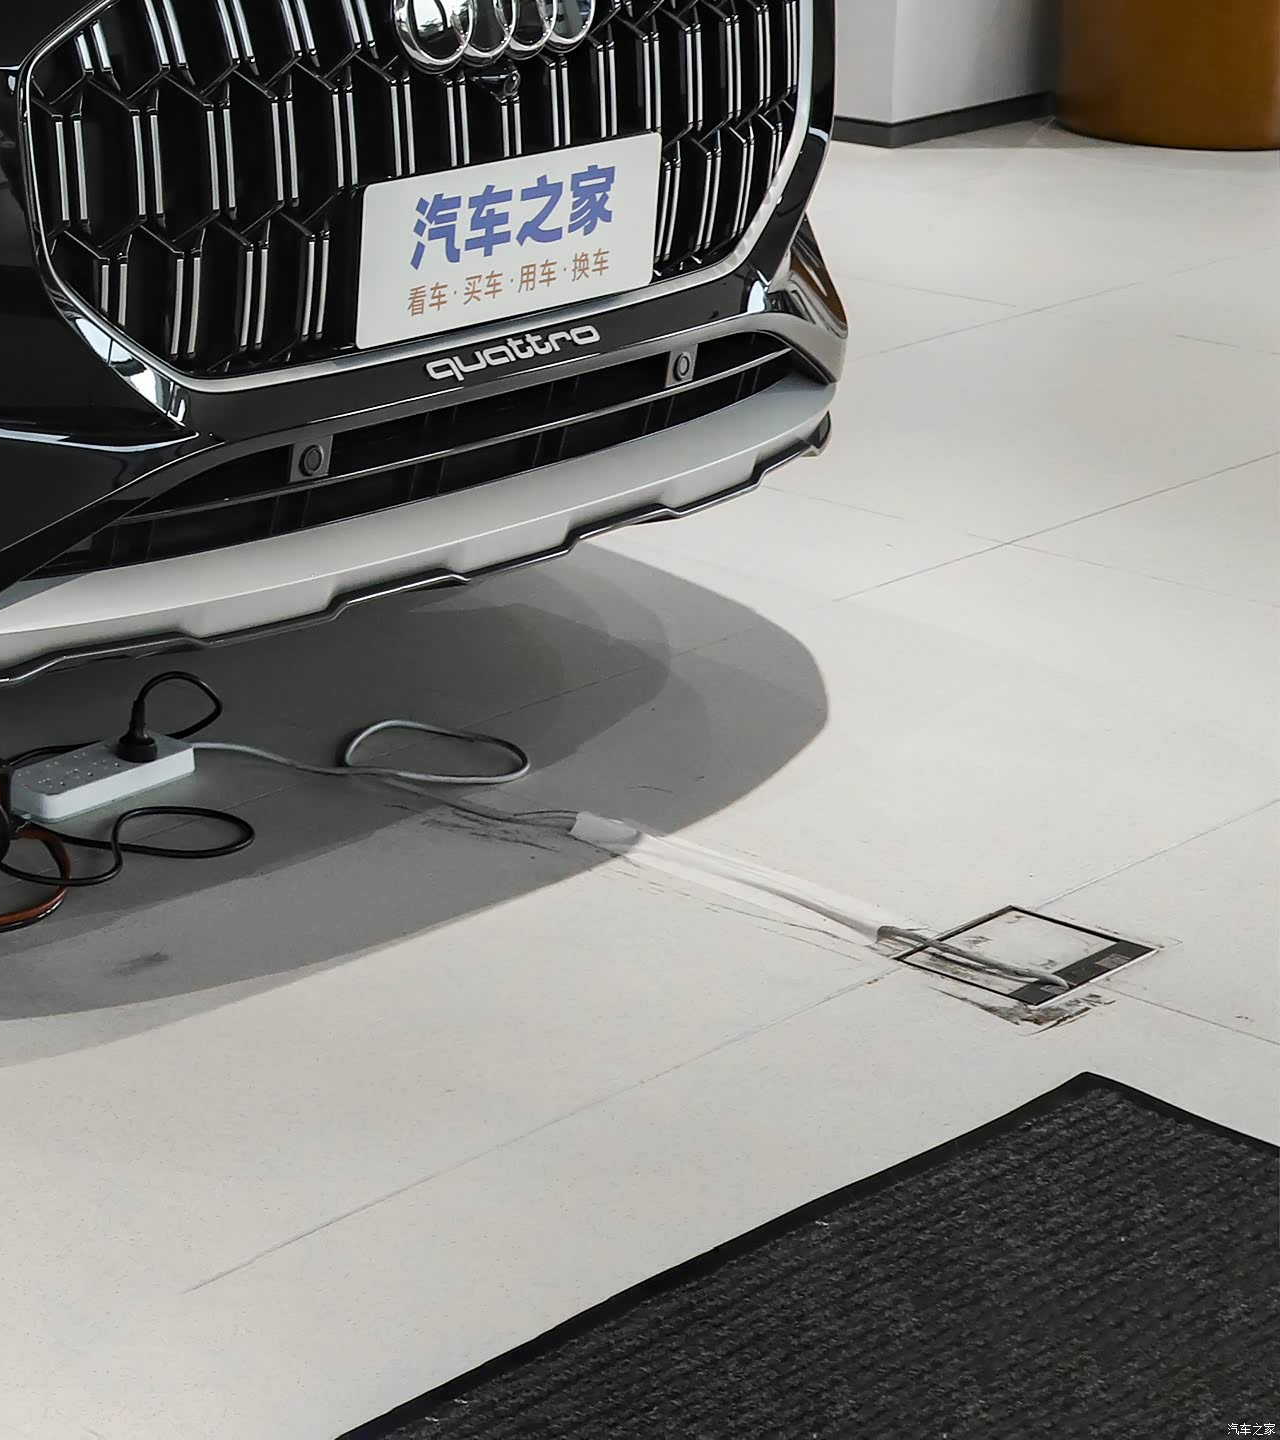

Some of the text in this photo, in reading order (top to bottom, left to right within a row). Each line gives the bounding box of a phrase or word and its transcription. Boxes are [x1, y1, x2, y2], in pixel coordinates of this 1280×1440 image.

[410, 165, 616, 271] 汽车之家
[426, 325, 601, 382] quattro
